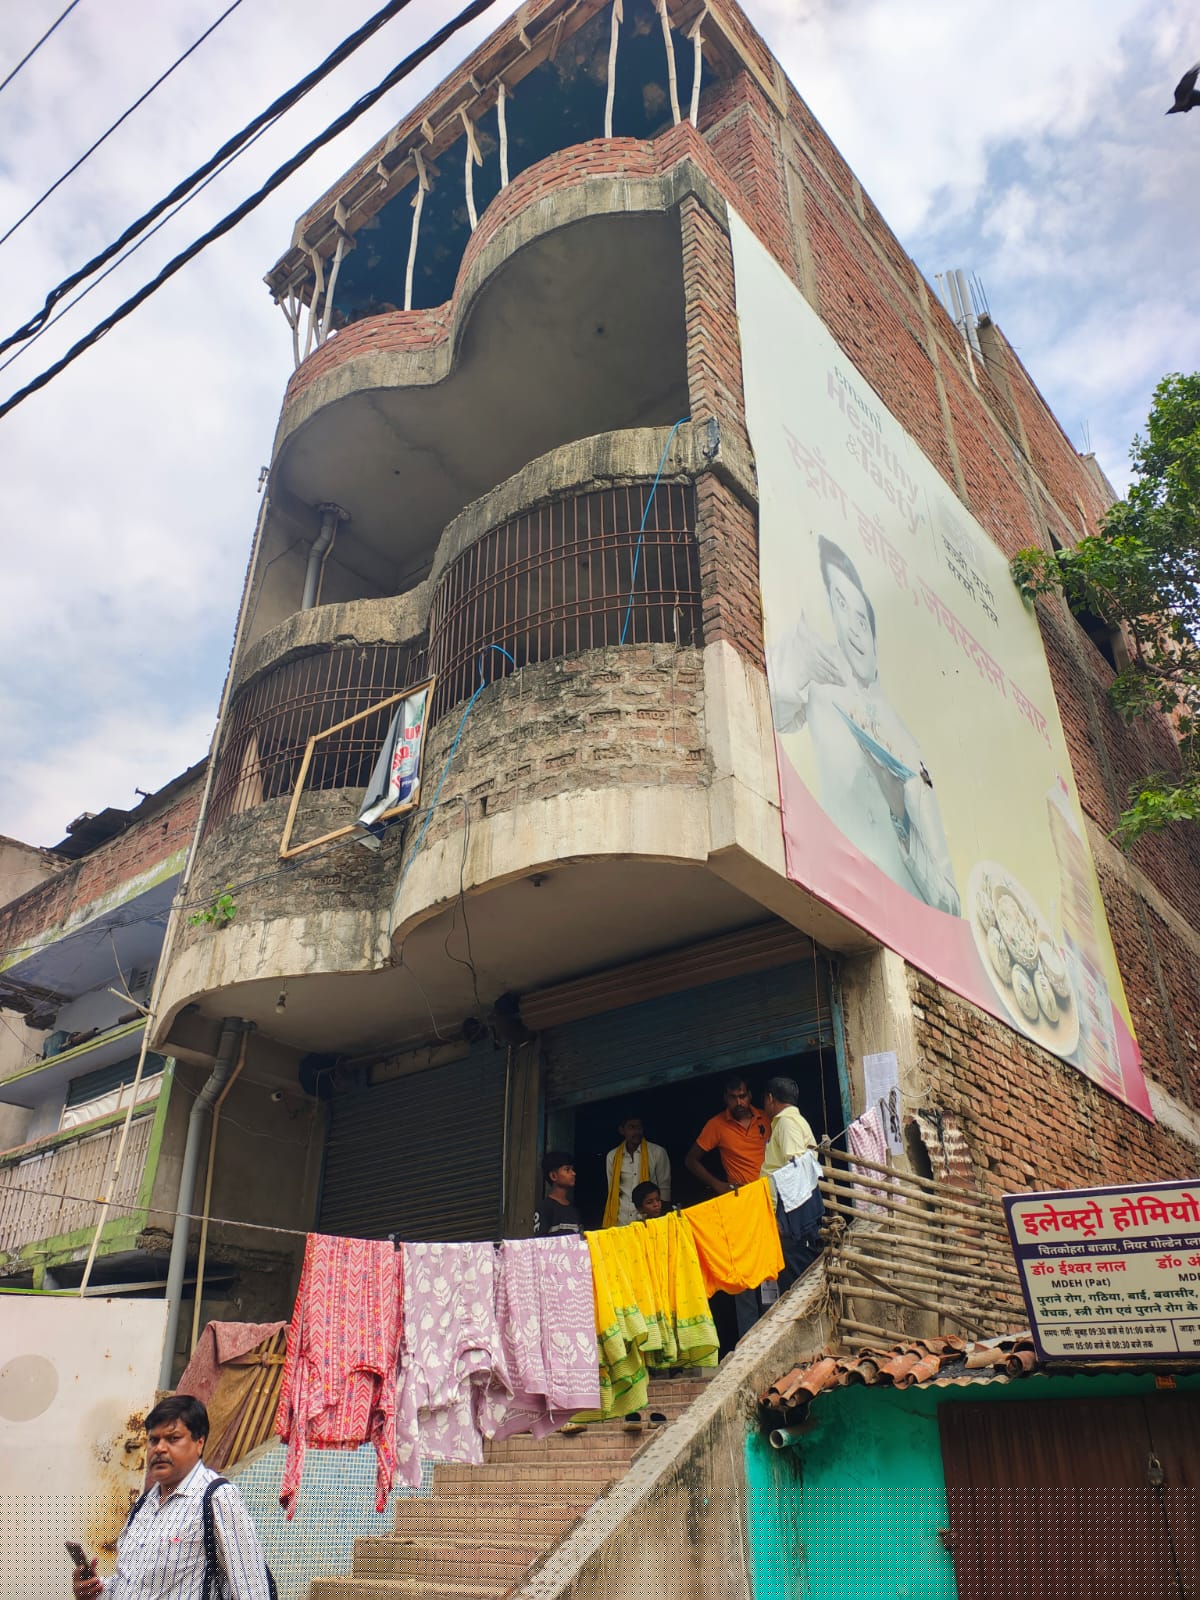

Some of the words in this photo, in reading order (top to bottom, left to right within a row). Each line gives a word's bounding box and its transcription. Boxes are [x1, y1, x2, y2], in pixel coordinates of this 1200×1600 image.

[834, 365, 882, 433] emami
[827, 370, 918, 505] Healthy
[1021, 1201, 1104, 1237] इलेक्ट्रो
[1038, 1244, 1085, 1255] चितकोहरा
[1123, 1240, 1147, 1251] नियर
[1058, 1260, 1092, 1276] ईश्वर
[1095, 1260, 1127, 1273] लाल
[1051, 1280, 1082, 1289] MDEH
[1085, 1277, 1111, 1288] (Pat)
[1036, 1293, 1061, 1306] पुराने
[1088, 1291, 1124, 1302] गठिया,
[1073, 1306, 1092, 1316] स्त्री
[1095, 1306, 1113, 1315] रोग
[1115, 1305, 1132, 1316] एवं
[1135, 1302, 1161, 1316] पुराने
[1163, 1302, 1183, 1312] रोग
[1186, 1301, 1198, 1311] के
[1125, 1326, 1143, 1334] 01:00
[1075, 1341, 1093, 1350] 05:00
[1111, 1340, 1130, 1349] 08:30
